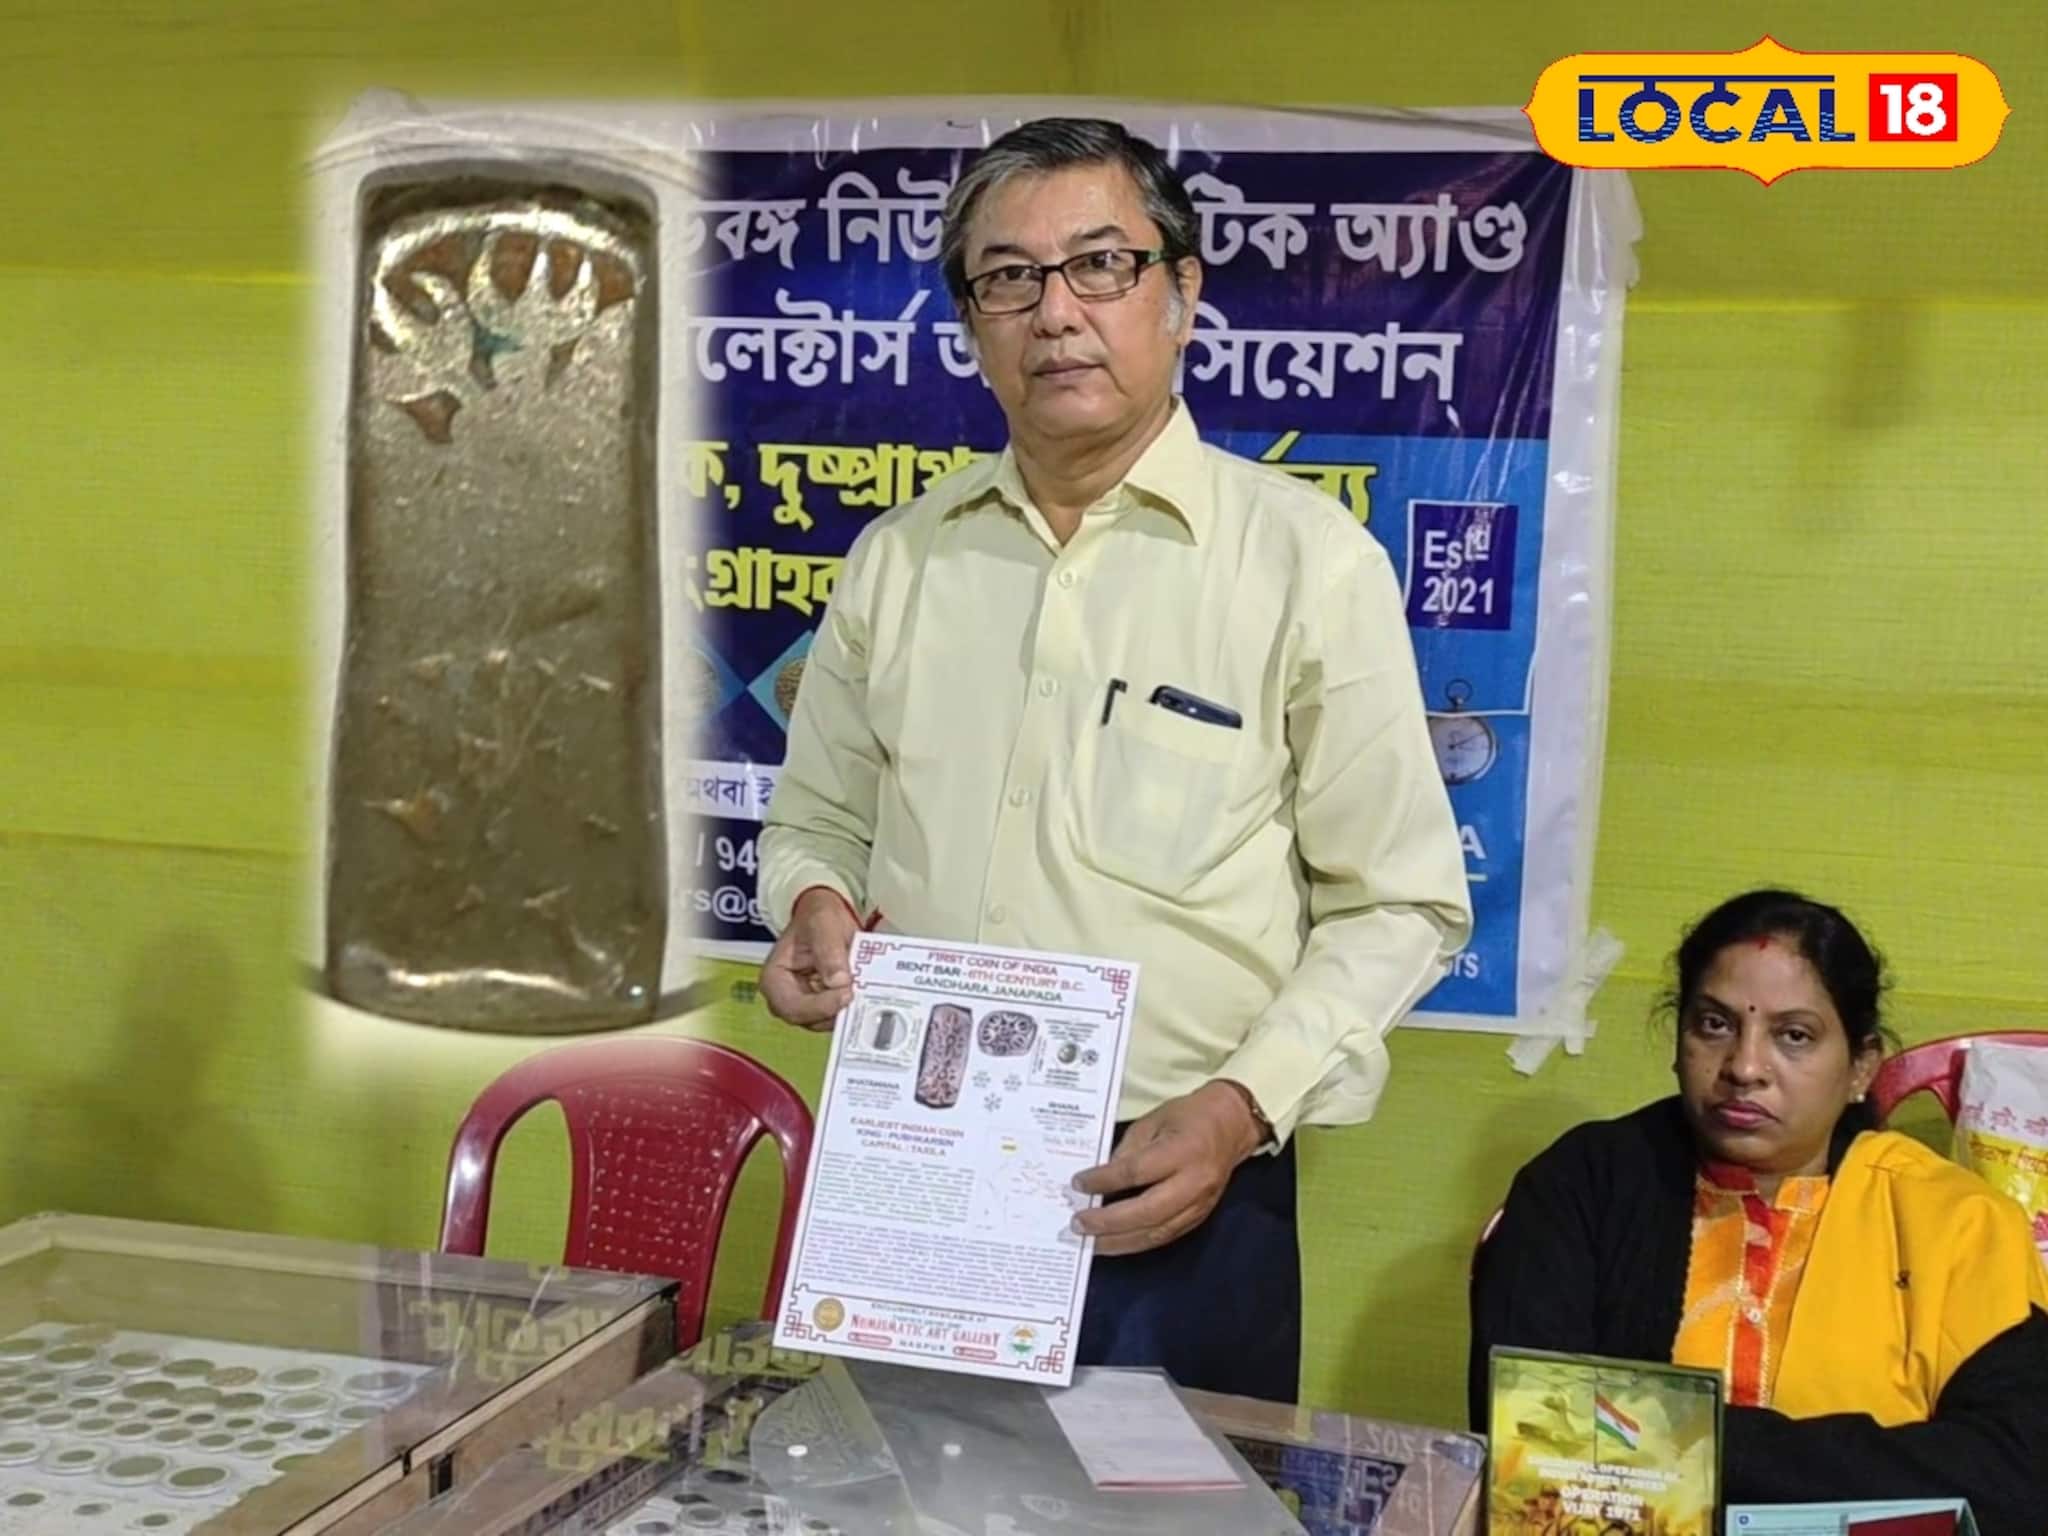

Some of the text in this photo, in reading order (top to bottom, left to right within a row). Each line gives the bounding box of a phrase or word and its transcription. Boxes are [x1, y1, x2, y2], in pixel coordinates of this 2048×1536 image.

[686, 199, 807, 270] বঙ্গ
[683, 288, 931, 387] লেক্টার্স
[1421, 578, 1494, 614] 2021
[715, 837, 758, 876] 94
[1461, 824, 1487, 860] A
[896, 960, 932, 973] BENT
[934, 963, 961, 977] BAR
[996, 972, 1059, 989] CENTURY
[928, 951, 1058, 976] FIRST COIN OF INDIA
[914, 975, 1063, 1002] GANDHARA JANAPADA
